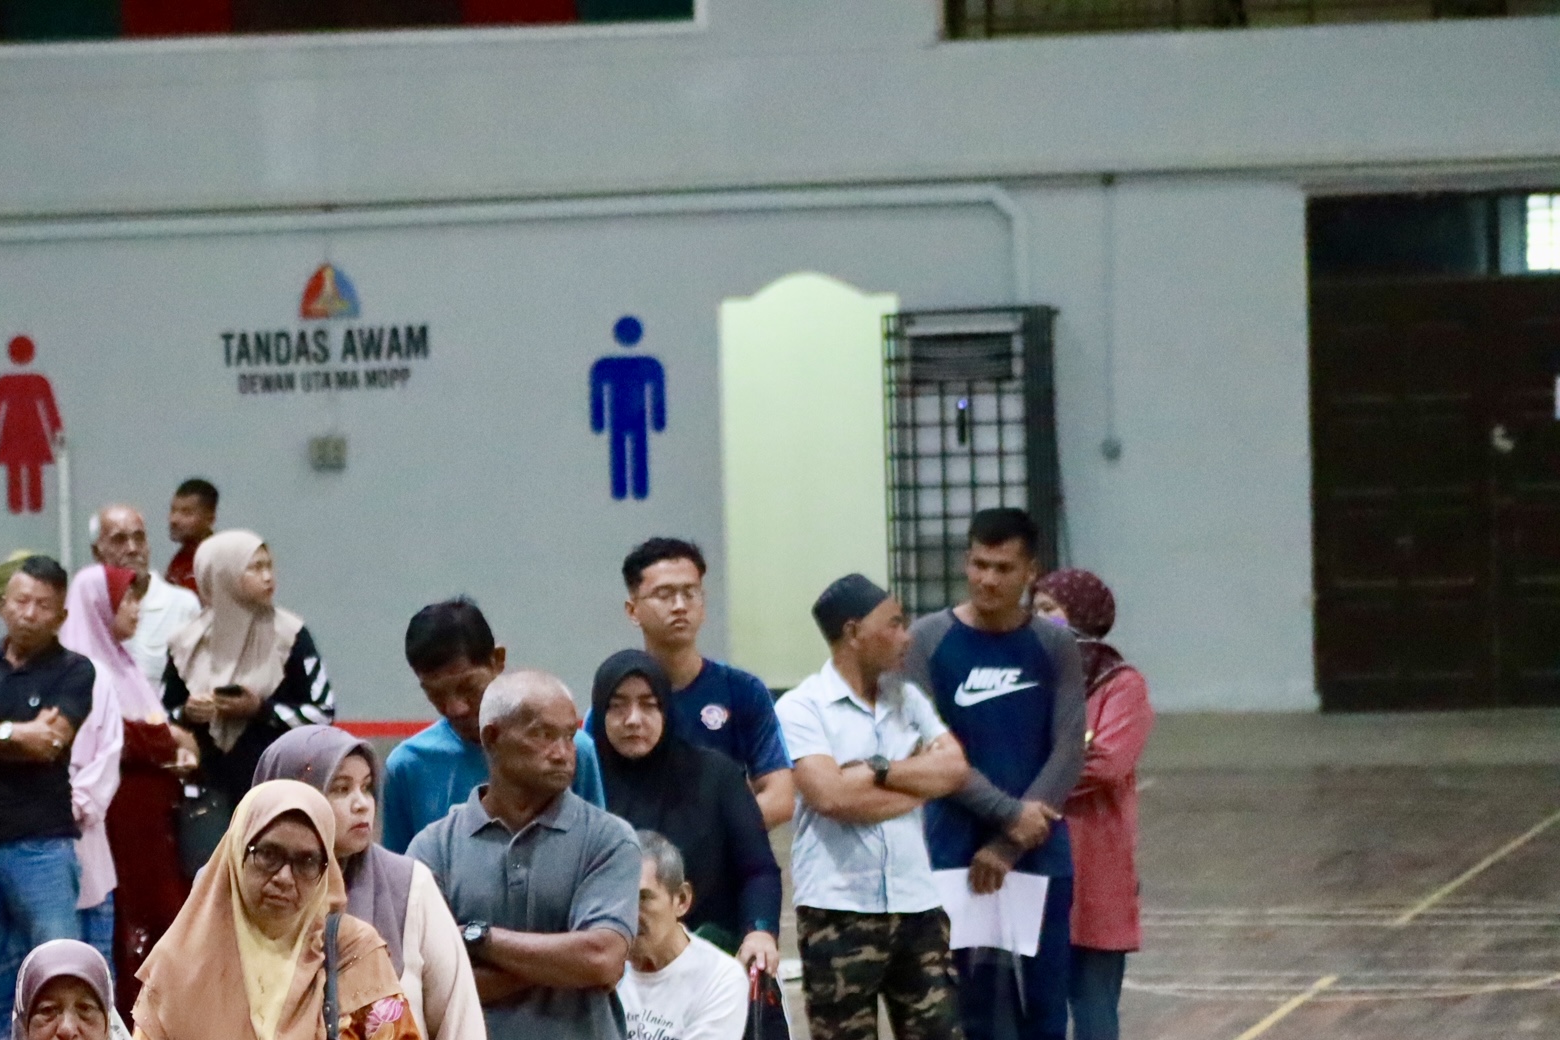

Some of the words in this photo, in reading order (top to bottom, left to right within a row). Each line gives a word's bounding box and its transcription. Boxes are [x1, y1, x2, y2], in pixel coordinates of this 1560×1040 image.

[220, 330, 331, 367] TANDAS
[341, 323, 429, 361] AWAM
[238, 371, 295, 394] DEWAN
[964, 666, 1023, 690] NIKE
